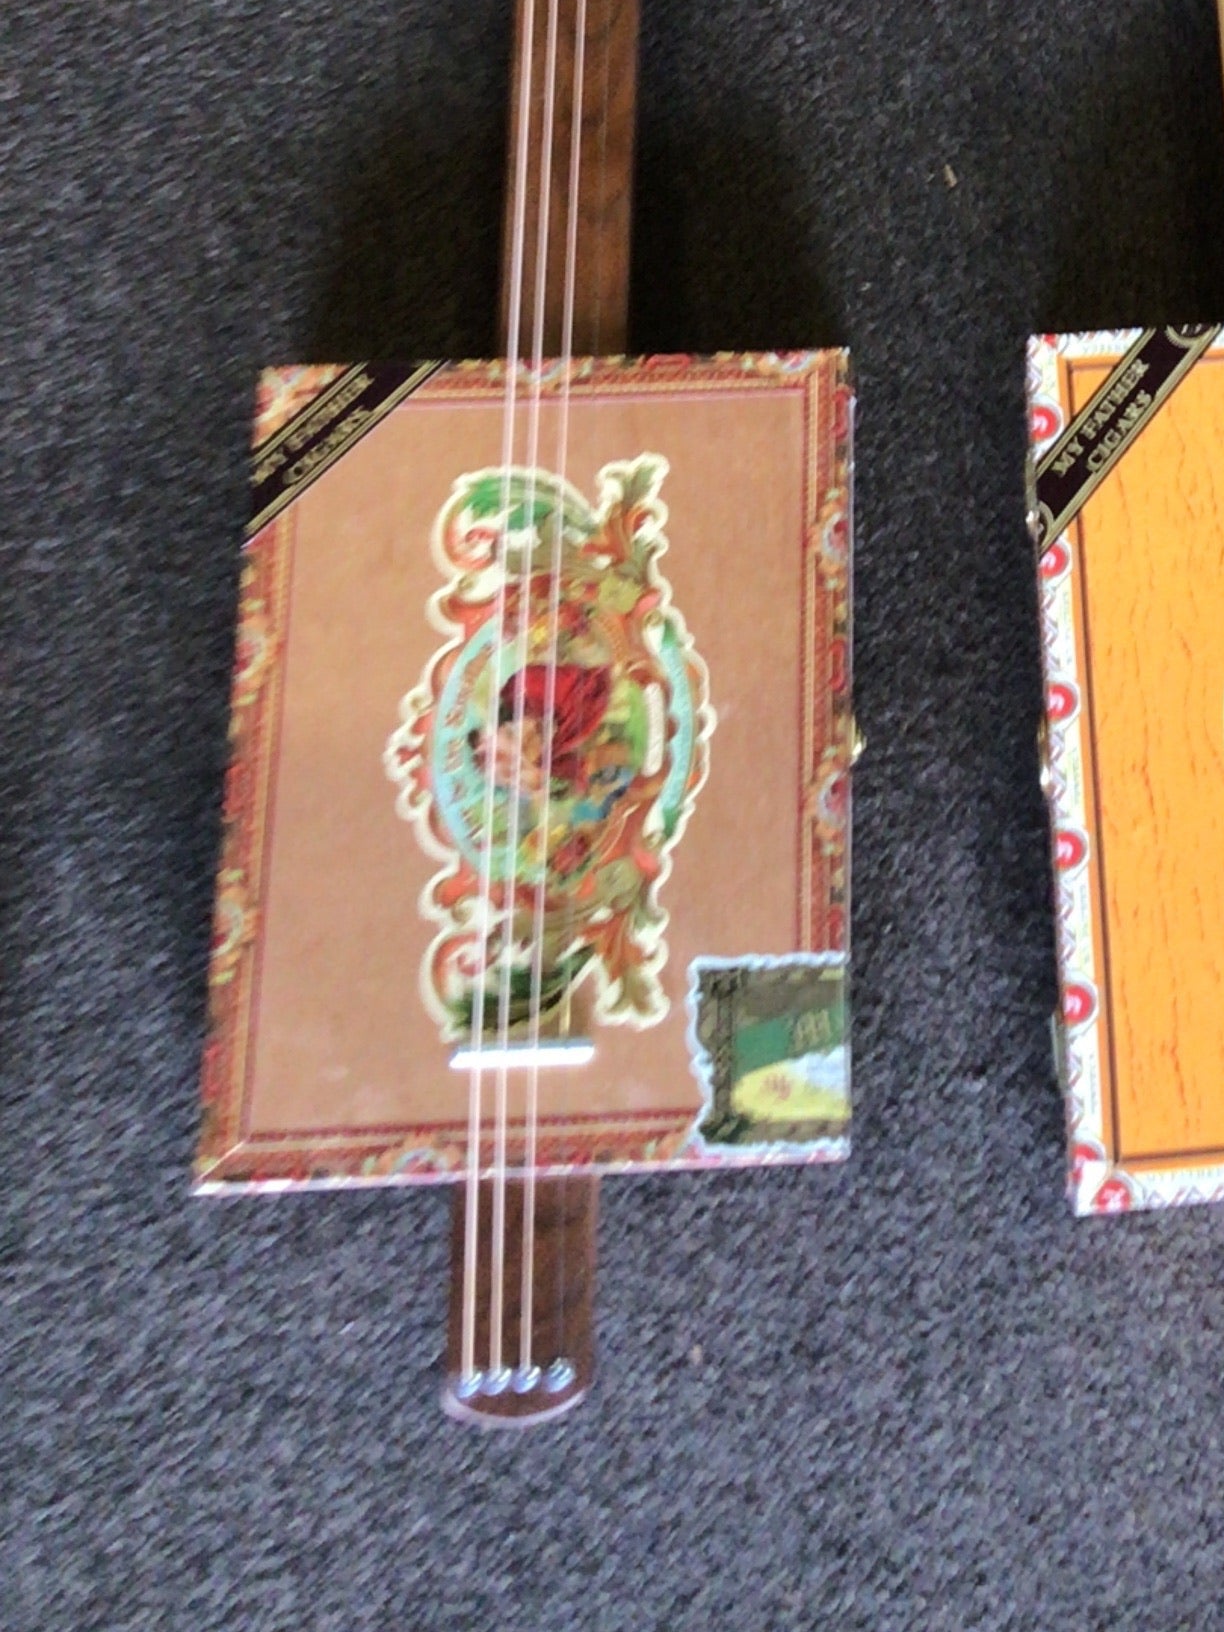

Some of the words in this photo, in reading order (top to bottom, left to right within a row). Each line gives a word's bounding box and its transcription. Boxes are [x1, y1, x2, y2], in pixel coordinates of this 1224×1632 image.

[1051, 436, 1084, 477] MY
[1081, 358, 1150, 440] FATHER
[1086, 389, 1152, 473] CIGARS
